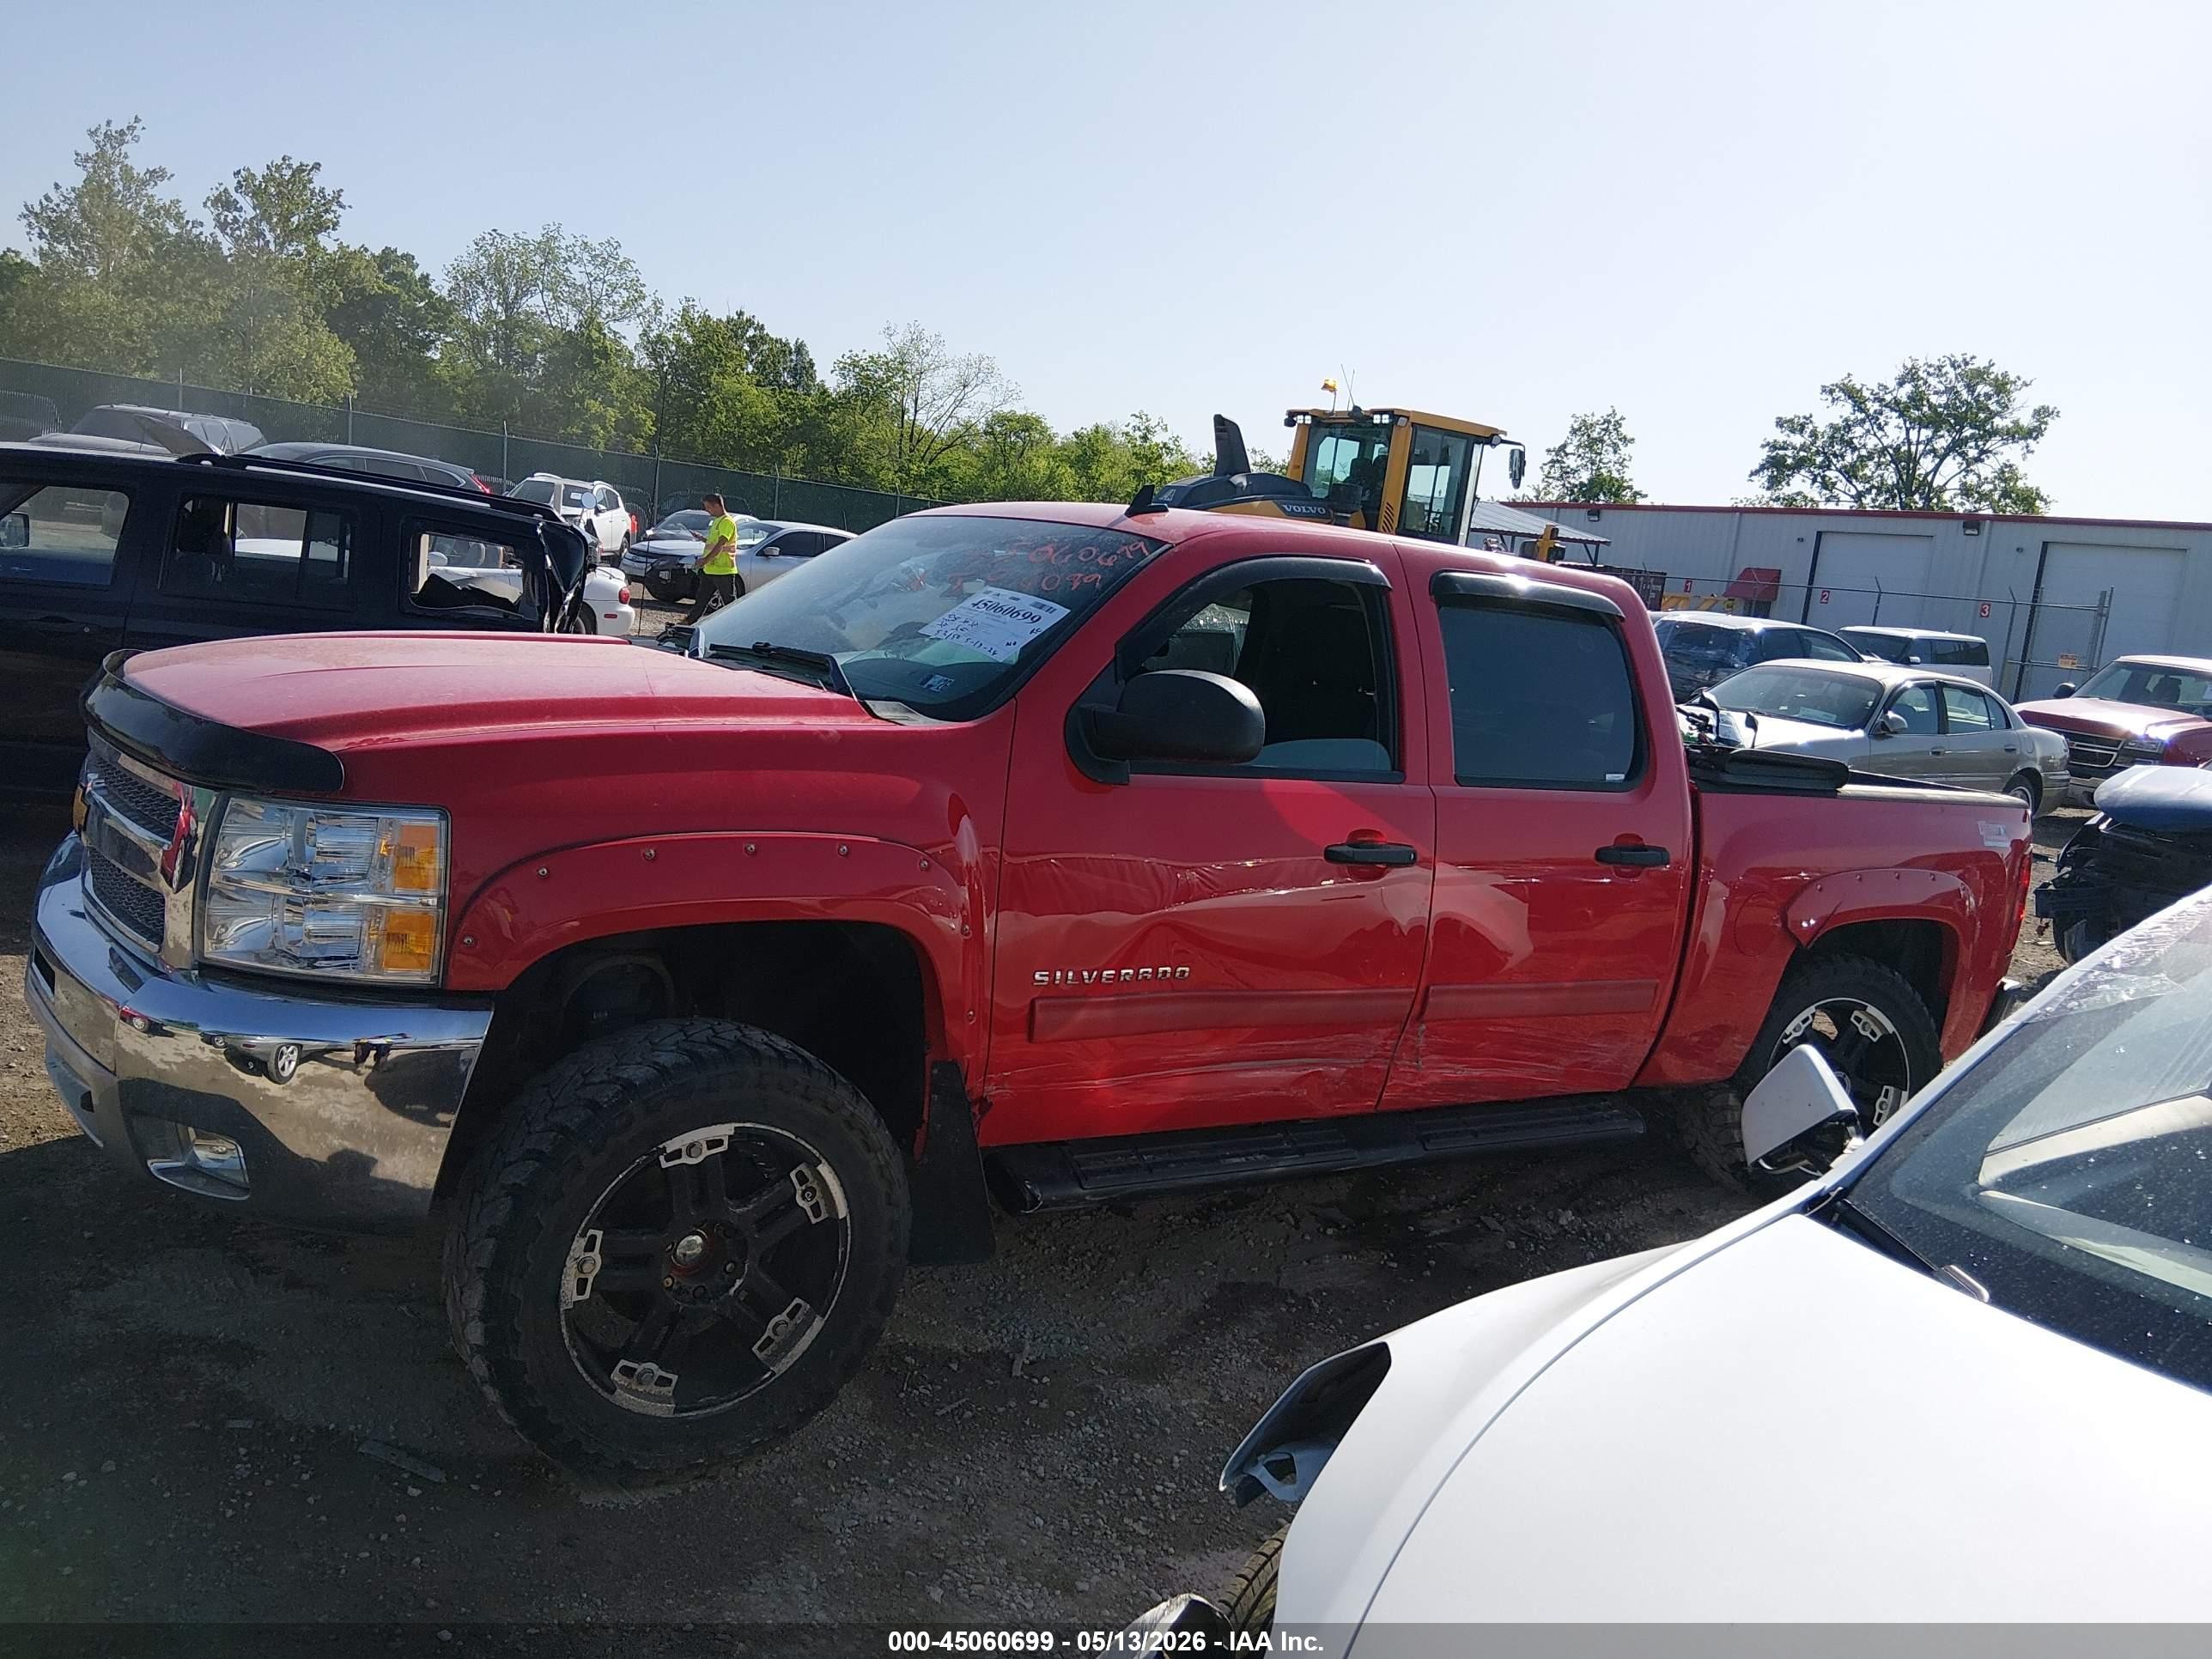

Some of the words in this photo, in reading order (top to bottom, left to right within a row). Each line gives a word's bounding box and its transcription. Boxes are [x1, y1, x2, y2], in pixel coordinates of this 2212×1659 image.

[1281, 504, 1327, 514] VOLVO
[1821, 592, 1830, 603] 2
[971, 599, 1042, 623] 45060699
[1981, 604, 1990, 617] 3
[1033, 966, 1190, 986] SILVERADO
